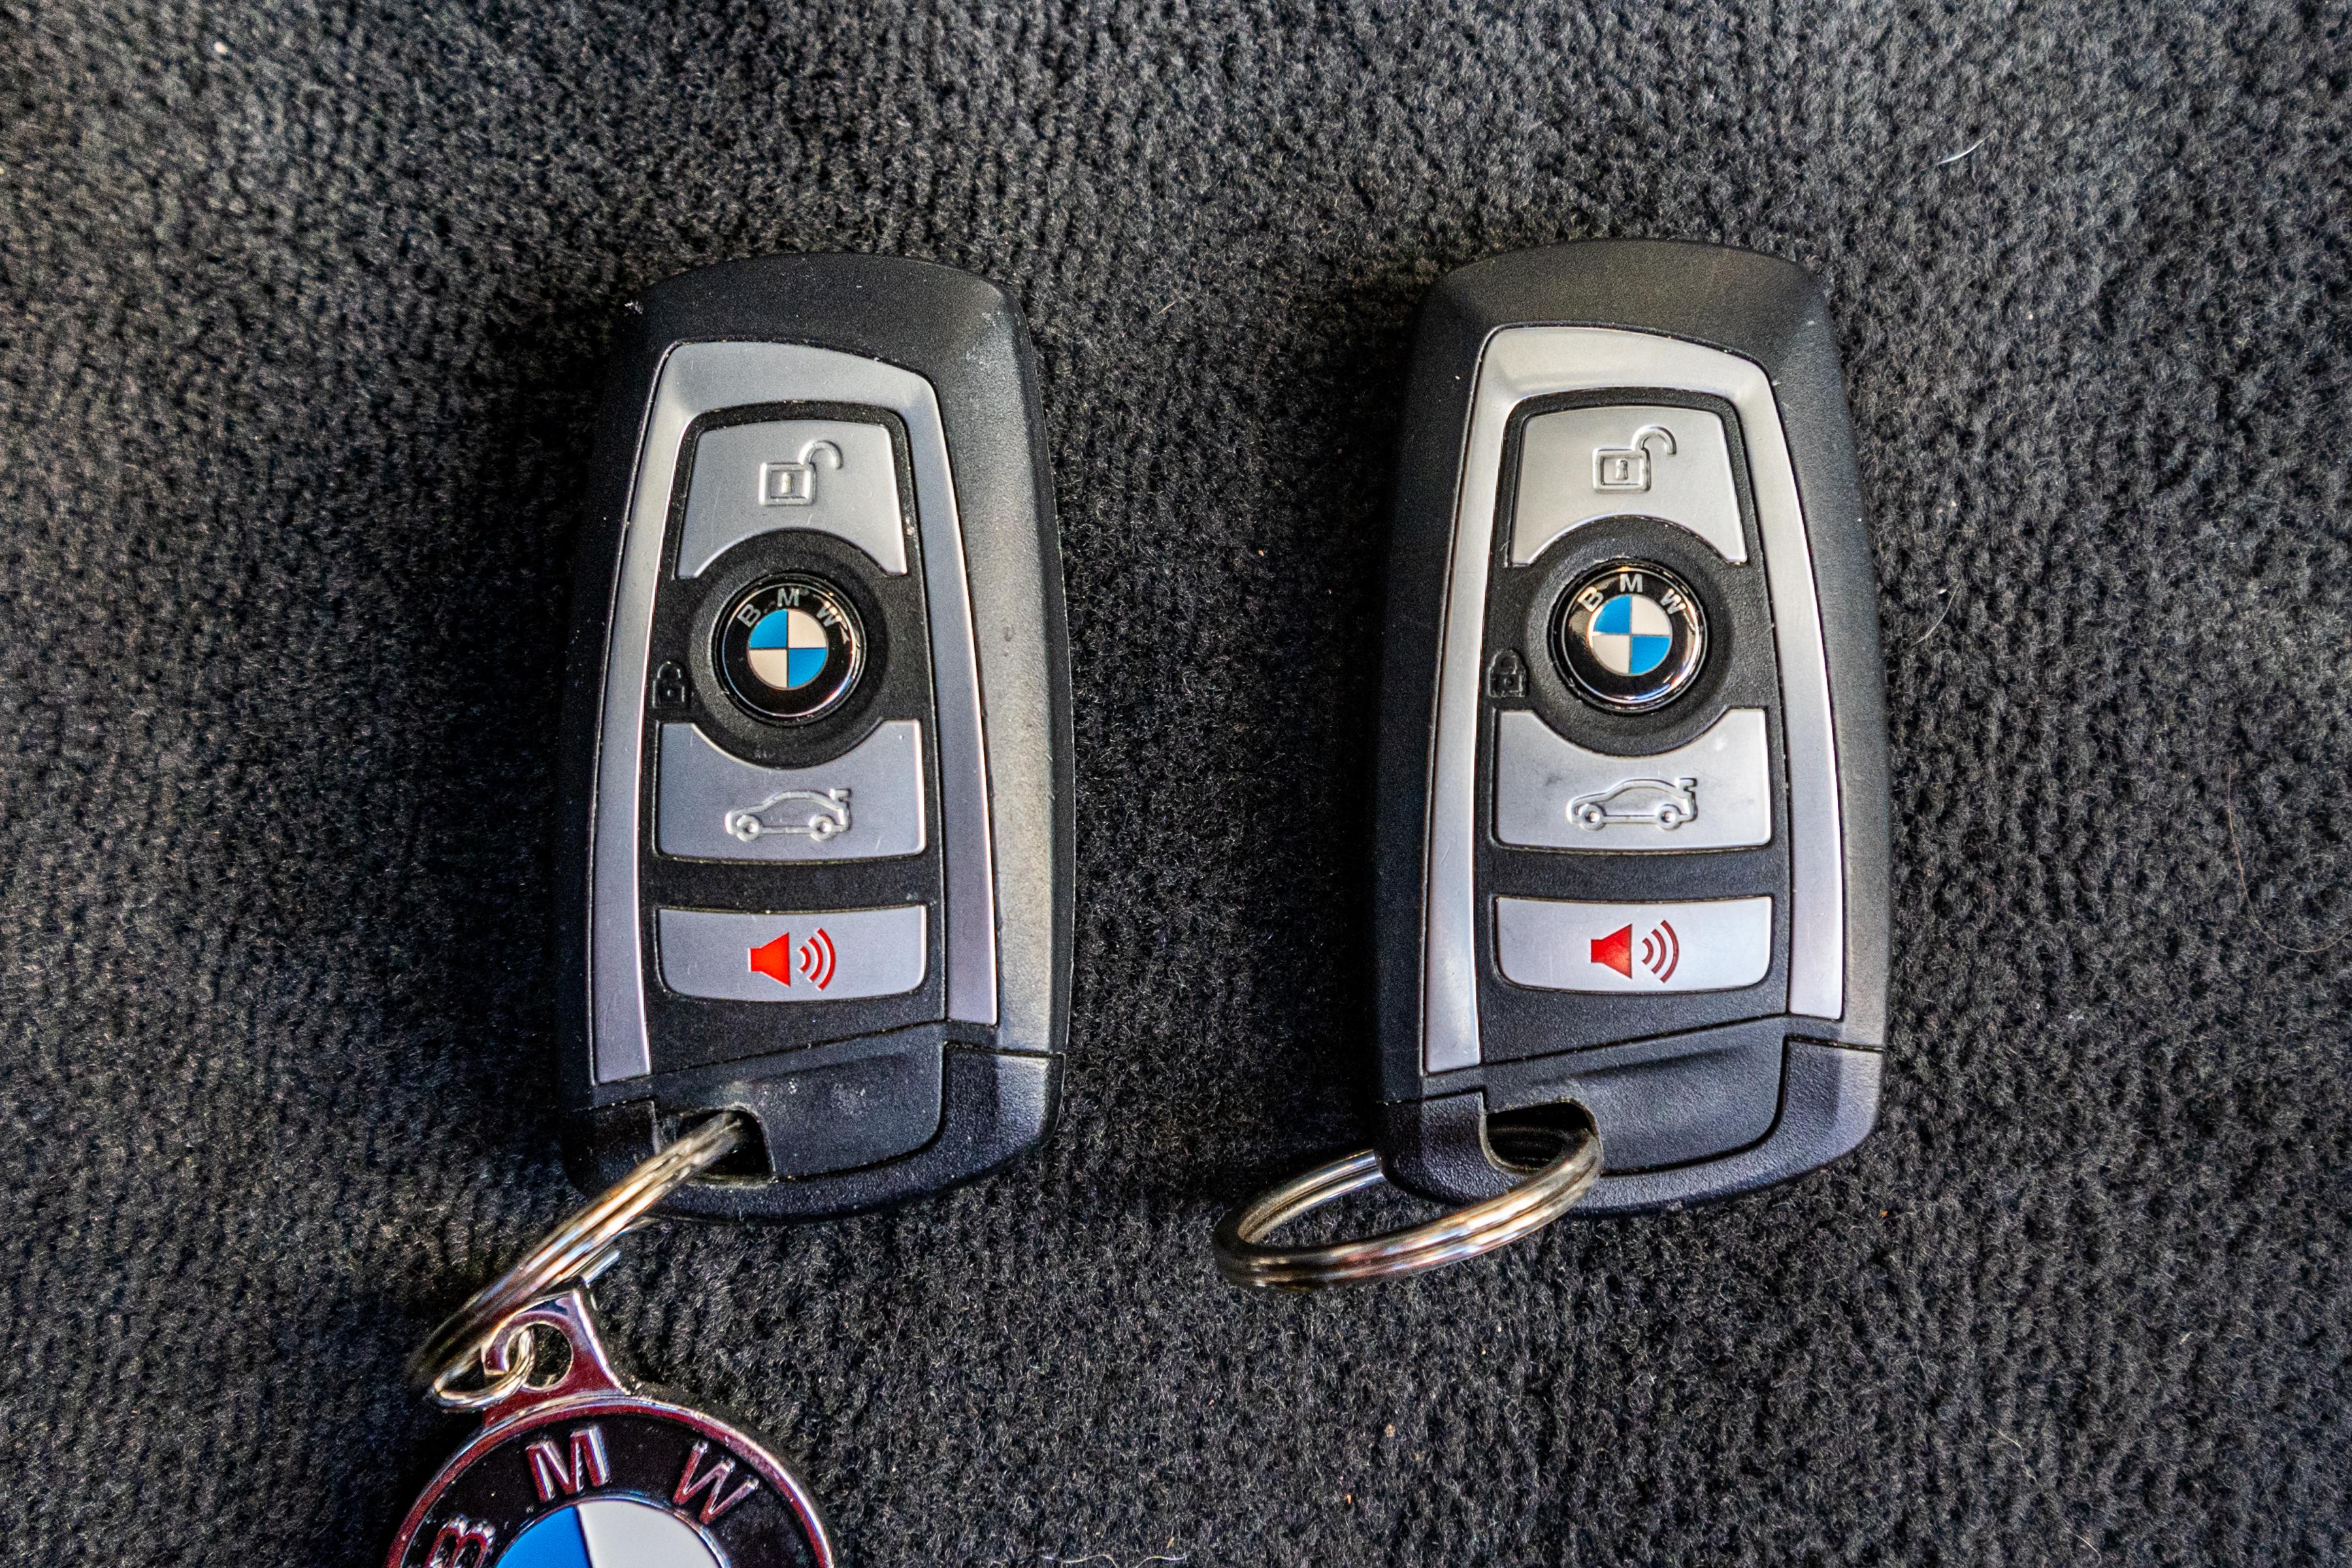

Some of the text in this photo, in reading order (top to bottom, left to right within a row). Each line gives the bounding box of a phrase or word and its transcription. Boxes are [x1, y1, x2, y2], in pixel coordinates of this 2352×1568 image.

[737, 588, 841, 627] BMW
[1578, 574, 1686, 614] BMW
[423, 1424, 759, 1568] BMW
